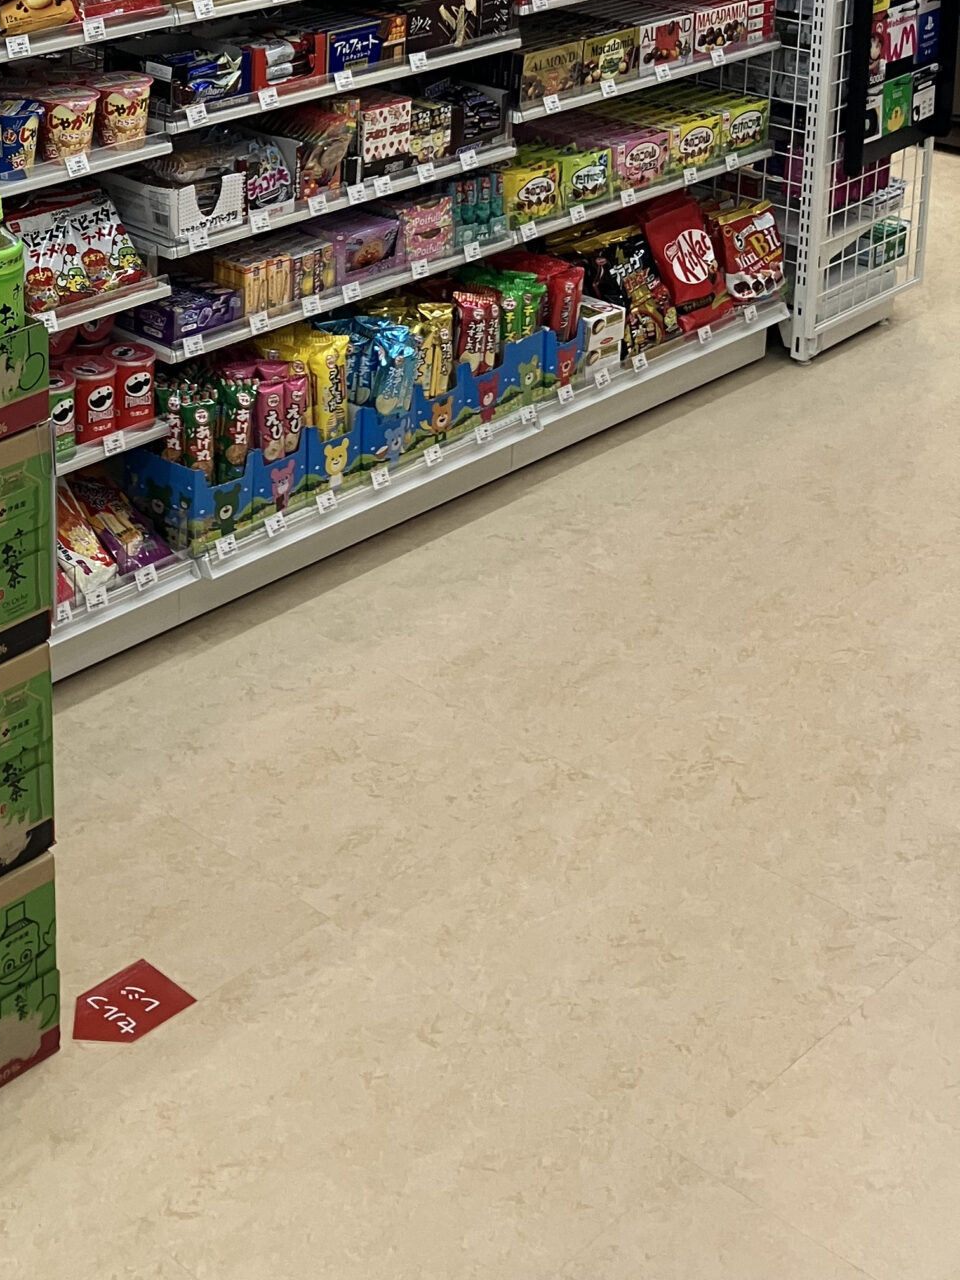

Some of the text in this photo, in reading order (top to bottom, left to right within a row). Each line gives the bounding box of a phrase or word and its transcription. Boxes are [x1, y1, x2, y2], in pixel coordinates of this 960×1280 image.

[697, 2, 747, 28] MACADAMIA
[642, 15, 691, 43] ALND
[334, 34, 379, 56] アルフォート
[591, 36, 635, 57] Macadamia
